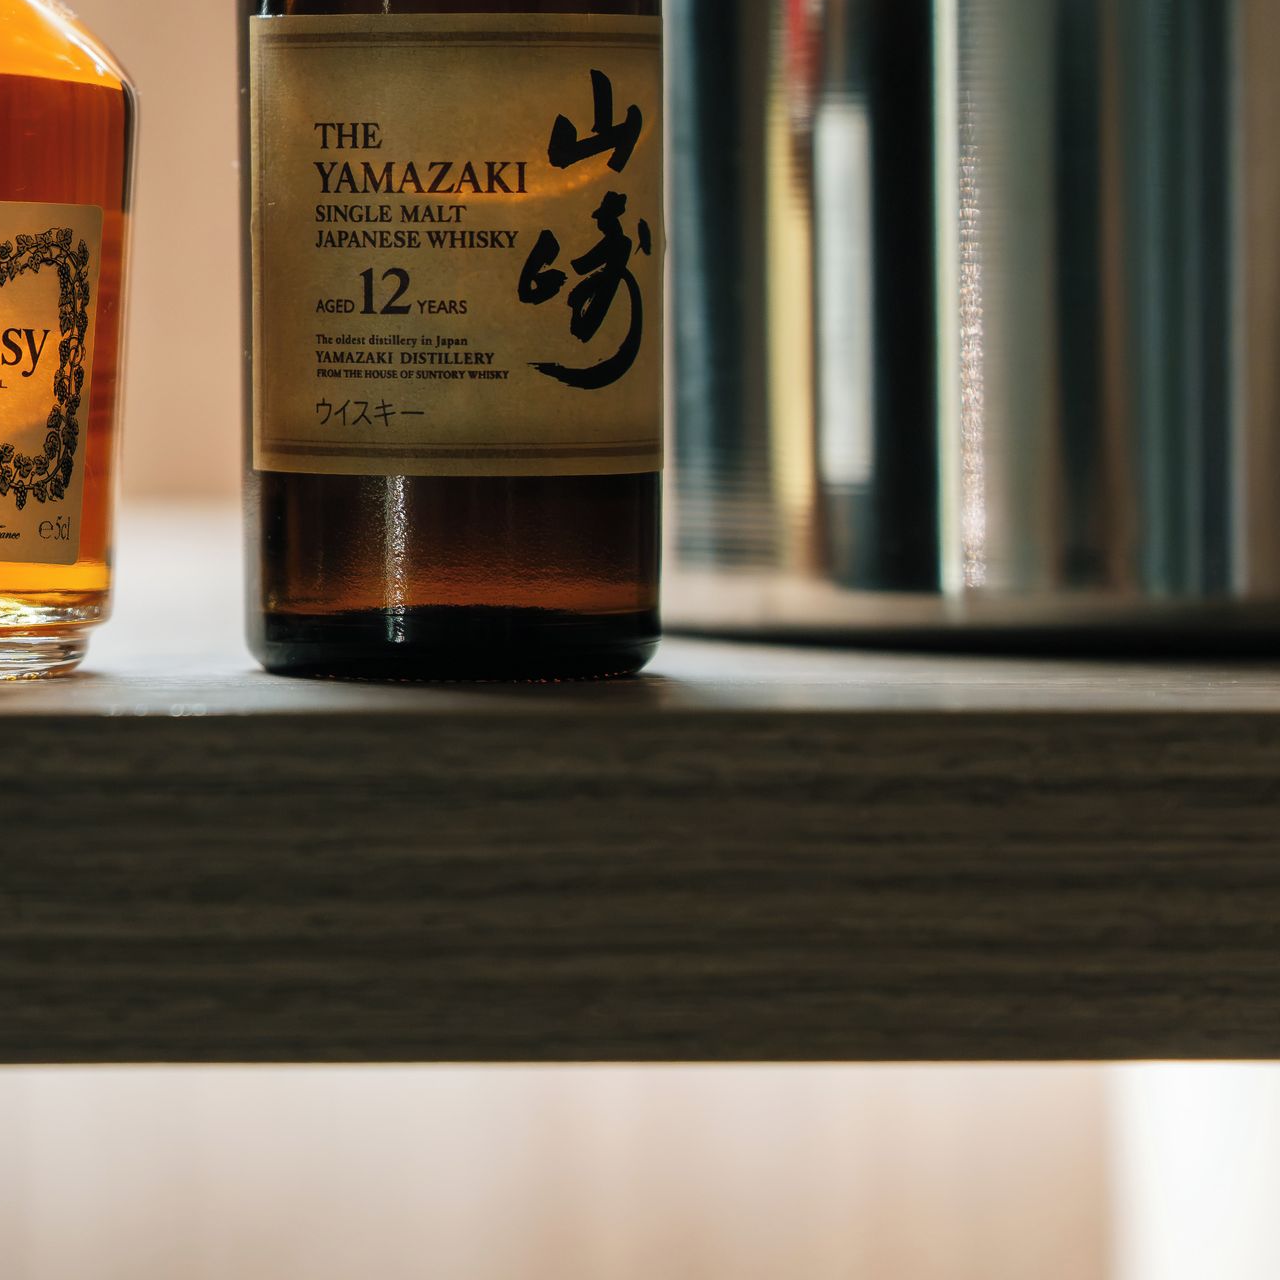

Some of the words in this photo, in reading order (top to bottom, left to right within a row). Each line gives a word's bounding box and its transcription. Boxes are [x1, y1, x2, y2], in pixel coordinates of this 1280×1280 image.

[314, 122, 383, 150] THE
[313, 161, 528, 194] YAMAZAKI
[315, 204, 394, 223] SINGLE
[400, 204, 467, 223] MALT
[315, 230, 424, 250] JAPANESE
[429, 230, 519, 250] WHISKY
[316, 299, 355, 313] AGED
[359, 267, 412, 315] 12
[417, 300, 467, 314] YEARS
[316, 334, 333, 345] The
[335, 334, 366, 345] oldest
[369, 334, 417, 348] distillery
[421, 335, 432, 345] in
[435, 336, 468, 348] Japan
[315, 351, 393, 364] YAMAZAKI
[400, 352, 495, 365] DISTILLERY
[316, 369, 341, 378] FROM
[344, 369, 363, 378] THE
[364, 369, 398, 378] HOUSE
[400, 370, 414, 379] OF
[416, 370, 465, 380] SUNTORY
[468, 370, 510, 380] WHISKY
[316, 398, 424, 426] ウイスキー
